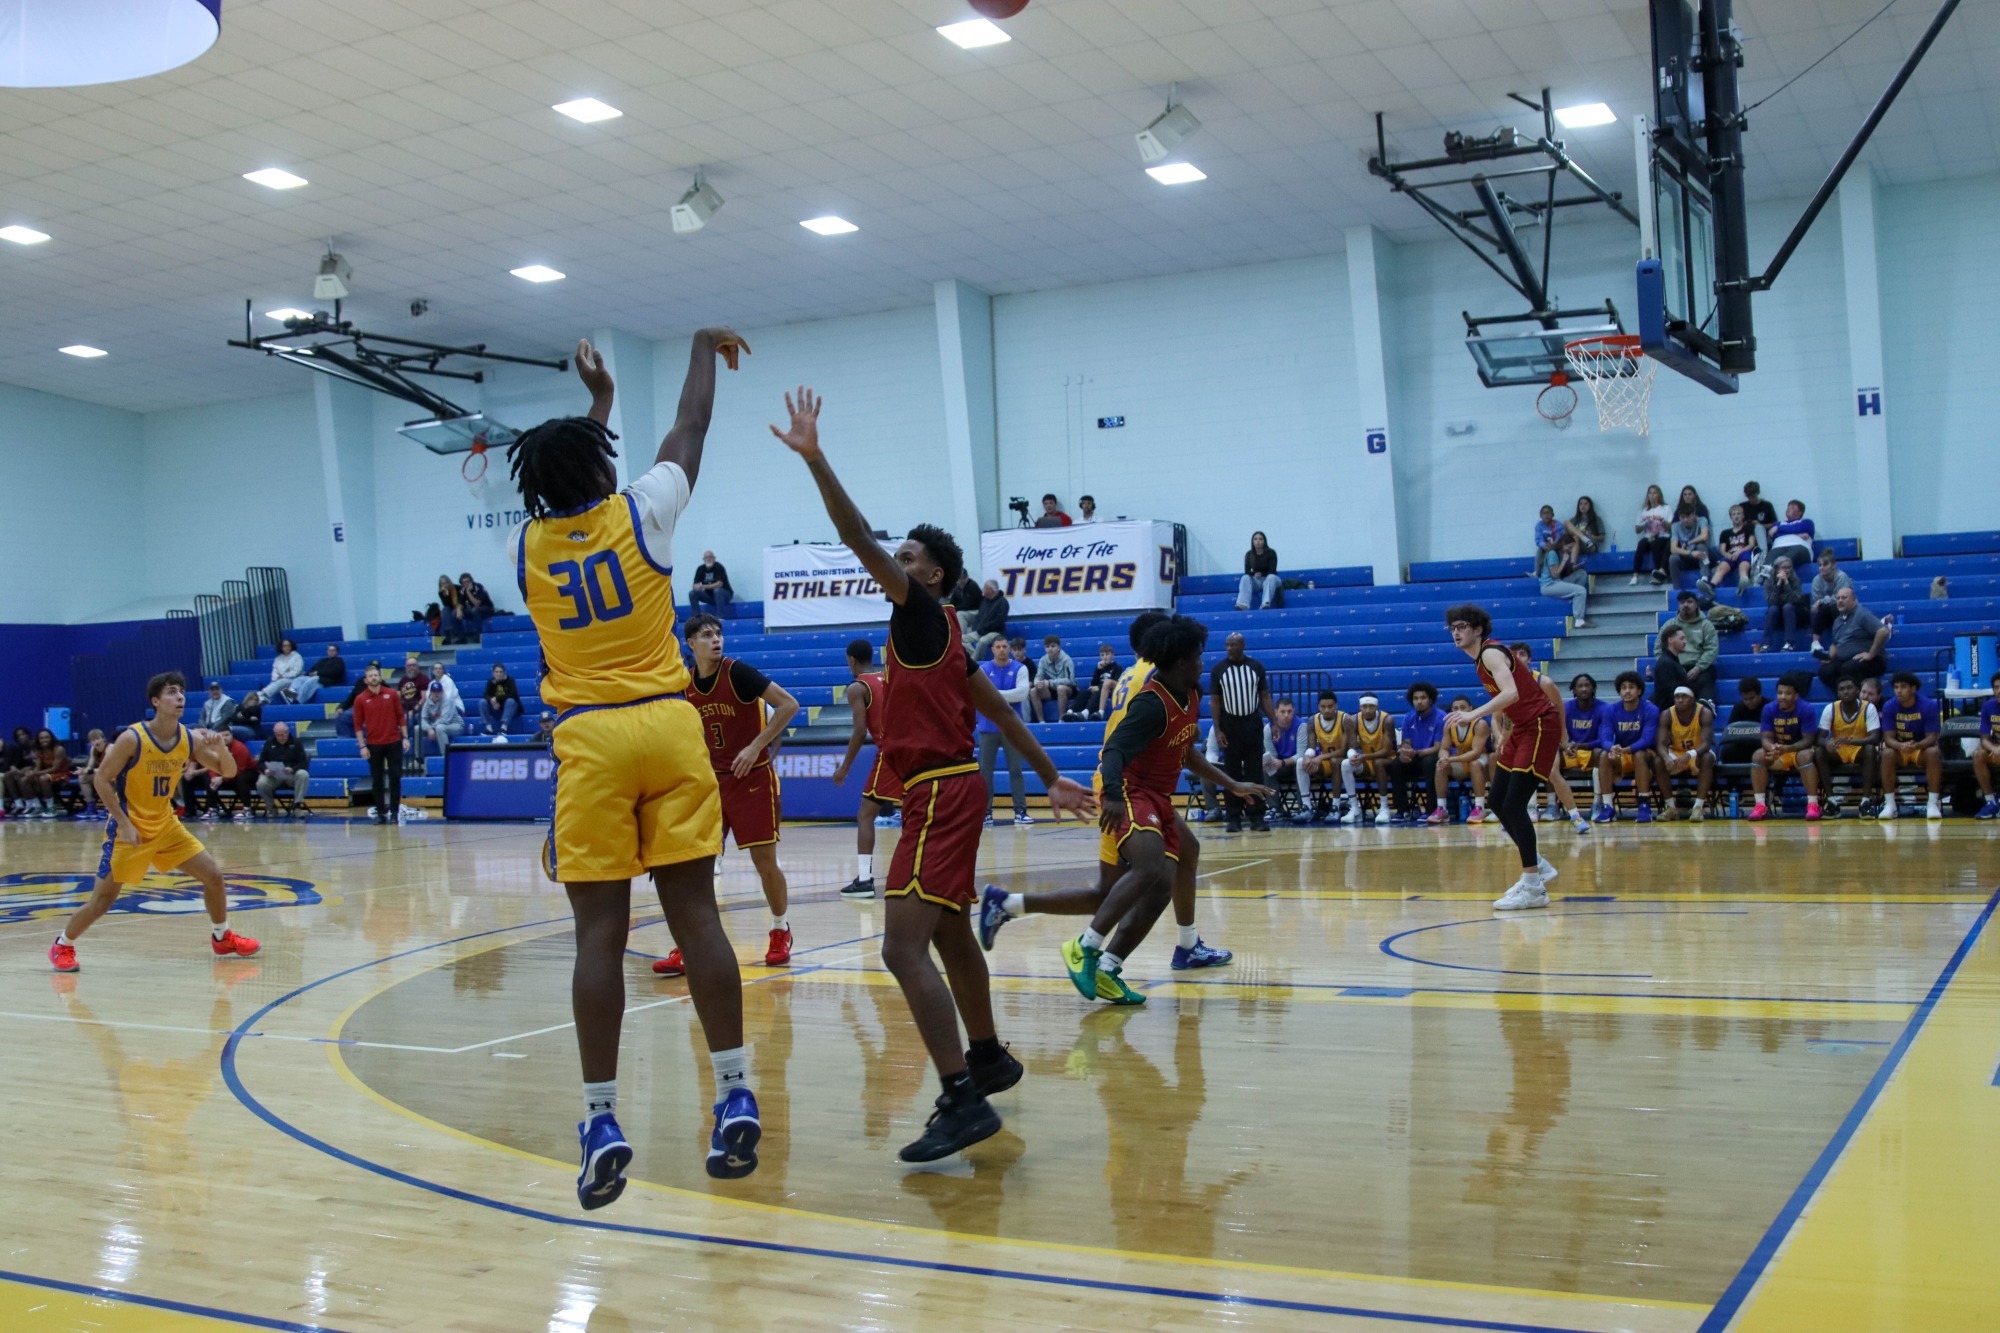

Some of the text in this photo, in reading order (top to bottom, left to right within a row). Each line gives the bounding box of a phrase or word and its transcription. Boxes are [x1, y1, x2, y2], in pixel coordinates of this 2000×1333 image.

[1858, 393, 1881, 416] H
[1367, 433, 1386, 454] G
[333, 527, 344, 542] E
[774, 570, 810, 579] CENTRAL
[812, 567, 856, 576] CHRISTIAN
[1001, 562, 1137, 598] TIGERS
[548, 549, 634, 630] 30
[772, 577, 886, 600] ATHLETIC
[699, 703, 736, 718] ESSTON
[710, 723, 725, 748] 3
[470, 758, 529, 780] 2025
[153, 776, 171, 797] 10
